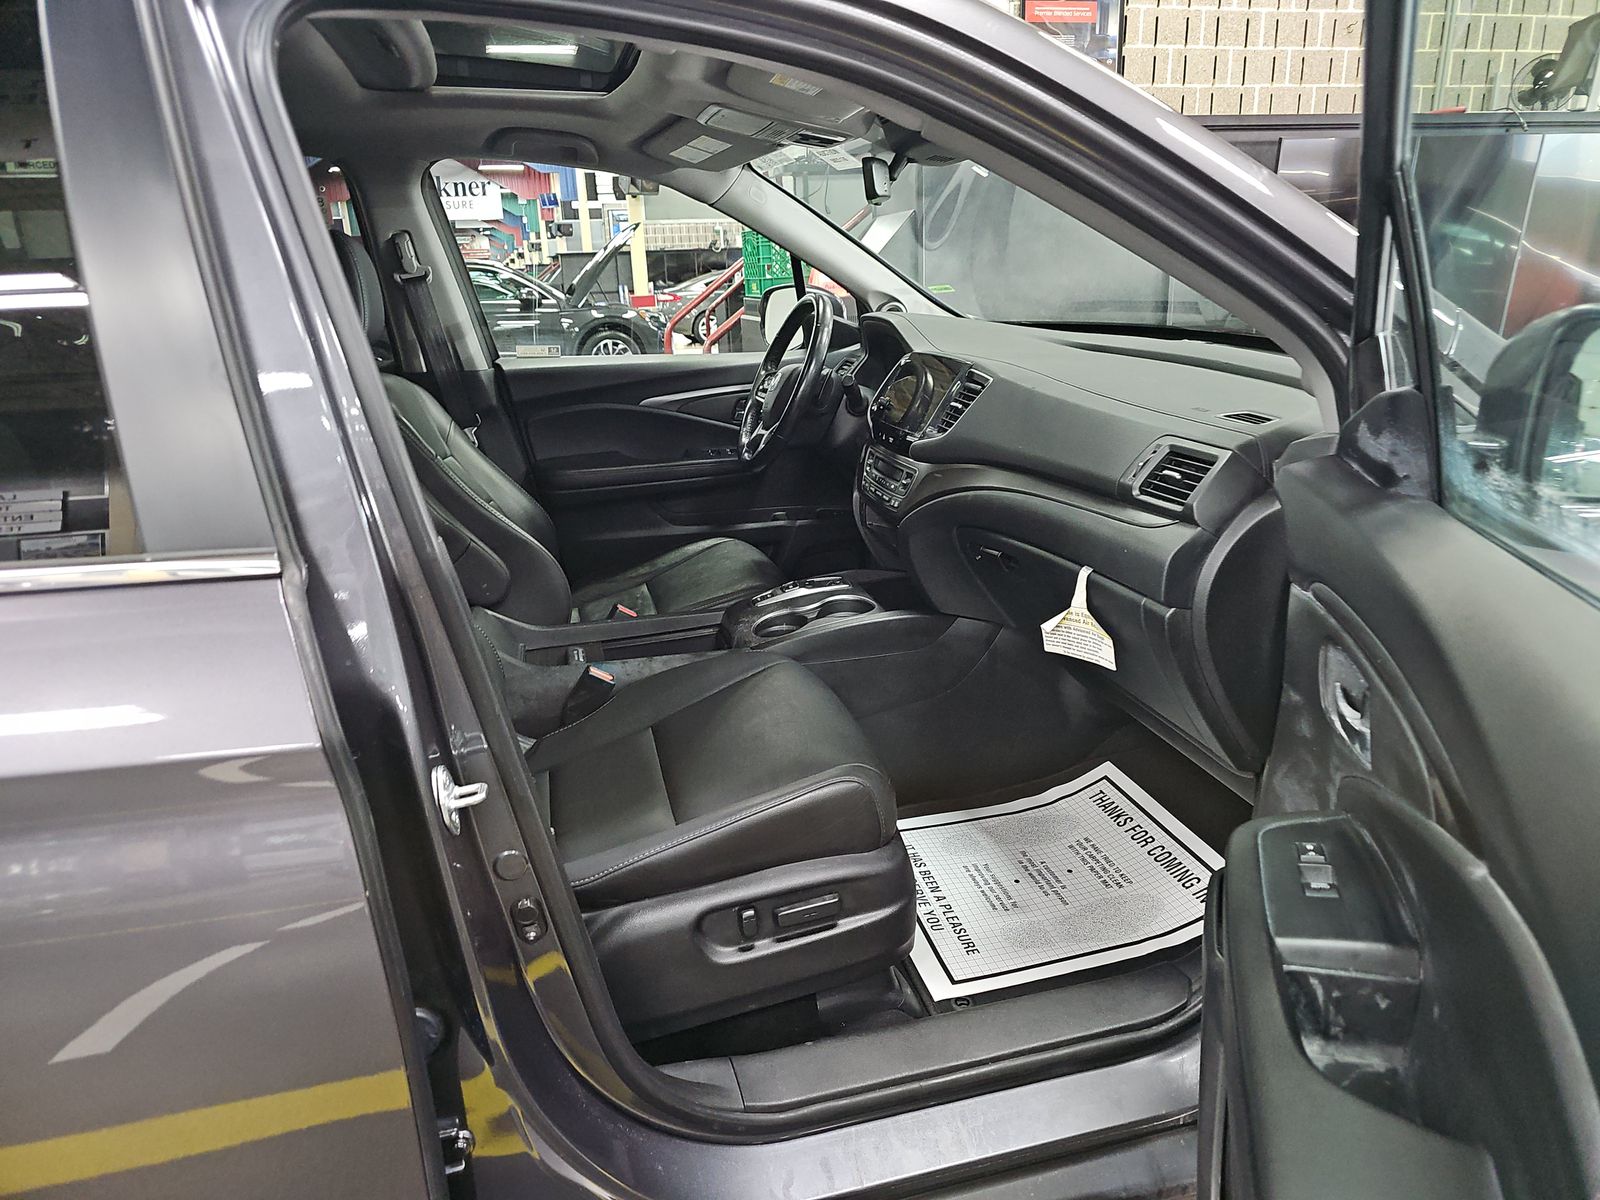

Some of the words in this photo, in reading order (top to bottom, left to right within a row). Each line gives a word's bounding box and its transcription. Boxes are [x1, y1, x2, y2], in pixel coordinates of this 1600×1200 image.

[434, 176, 491, 197] kner
[1088, 790, 1134, 827] THANKS
[1124, 824, 1156, 848] FOR
[1147, 845, 1201, 890] COMING
[1075, 839, 1088, 851] YOUR
[1085, 850, 1111, 875] CARPETING
[1107, 873, 1125, 889] CLEAN
[1078, 855, 1091, 866] THIS
[1087, 865, 1104, 880] PAPER
[1090, 843, 1104, 855] HAVE
[1101, 854, 1116, 868] TRIED
[1112, 866, 1122, 874] TO
[1119, 873, 1134, 885] KEEP
[908, 852, 927, 868] HAS
[919, 869, 942, 893] BEEN
[939, 903, 981, 956] PLEASURE
[923, 910, 945, 932] YOU
